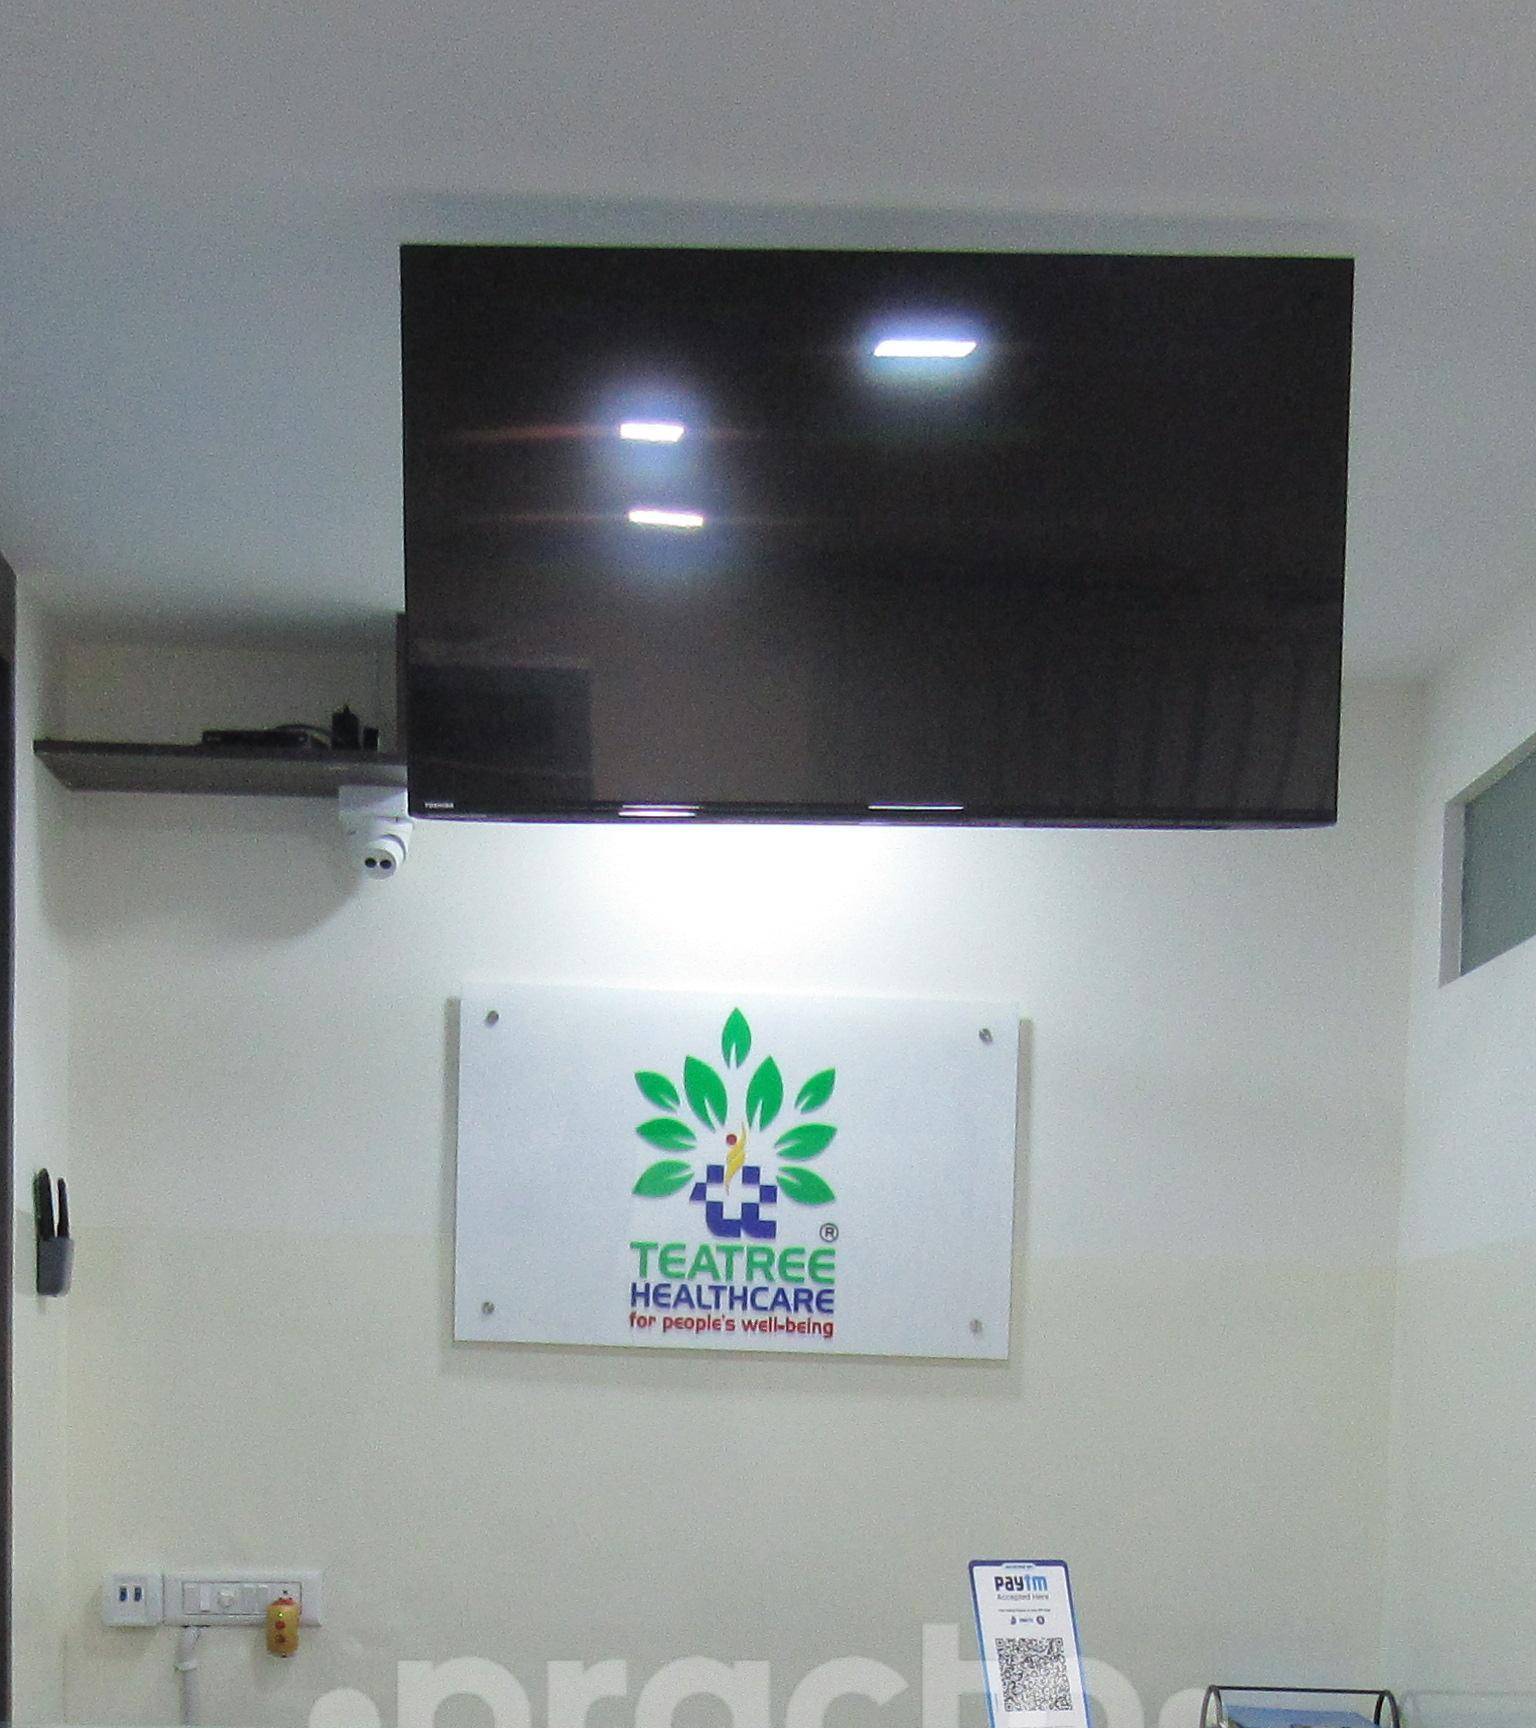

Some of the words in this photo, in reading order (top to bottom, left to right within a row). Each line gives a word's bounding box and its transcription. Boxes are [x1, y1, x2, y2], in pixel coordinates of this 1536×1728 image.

[629, 1241, 837, 1286] TEATREE
[629, 1283, 835, 1315] HEALTHCARE
[629, 1311, 658, 1330] for
[662, 1314, 737, 1336] people's
[741, 1317, 835, 1339] well-being
